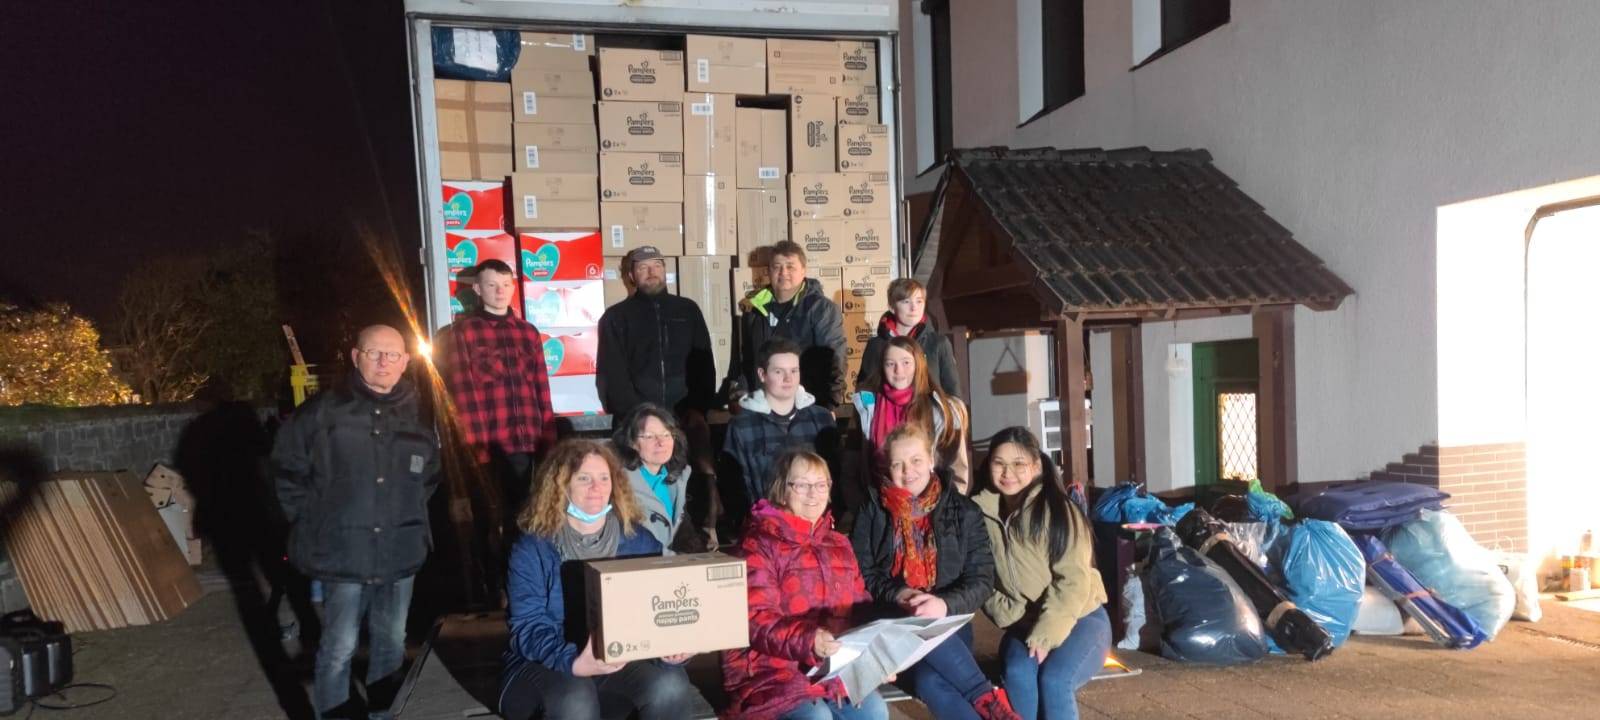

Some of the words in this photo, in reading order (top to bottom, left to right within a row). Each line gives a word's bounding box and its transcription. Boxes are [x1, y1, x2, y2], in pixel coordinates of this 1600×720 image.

[844, 52, 868, 61] Pampers
[628, 64, 656, 74] Pampers
[845, 99, 869, 107] Pampers
[627, 115, 655, 126] Pampers
[847, 138, 873, 147] Pampers
[628, 166, 655, 176] Pampers
[804, 186, 829, 195] Pampers
[850, 185, 874, 194] Pampers
[805, 233, 831, 242] Pampers
[855, 233, 880, 241] Pampers
[526, 258, 554, 268] Pampers
[589, 266, 596, 275] 6
[851, 280, 876, 289] Pampers
[651, 595, 700, 612] Pampers
[679, 614, 698, 625] pants
